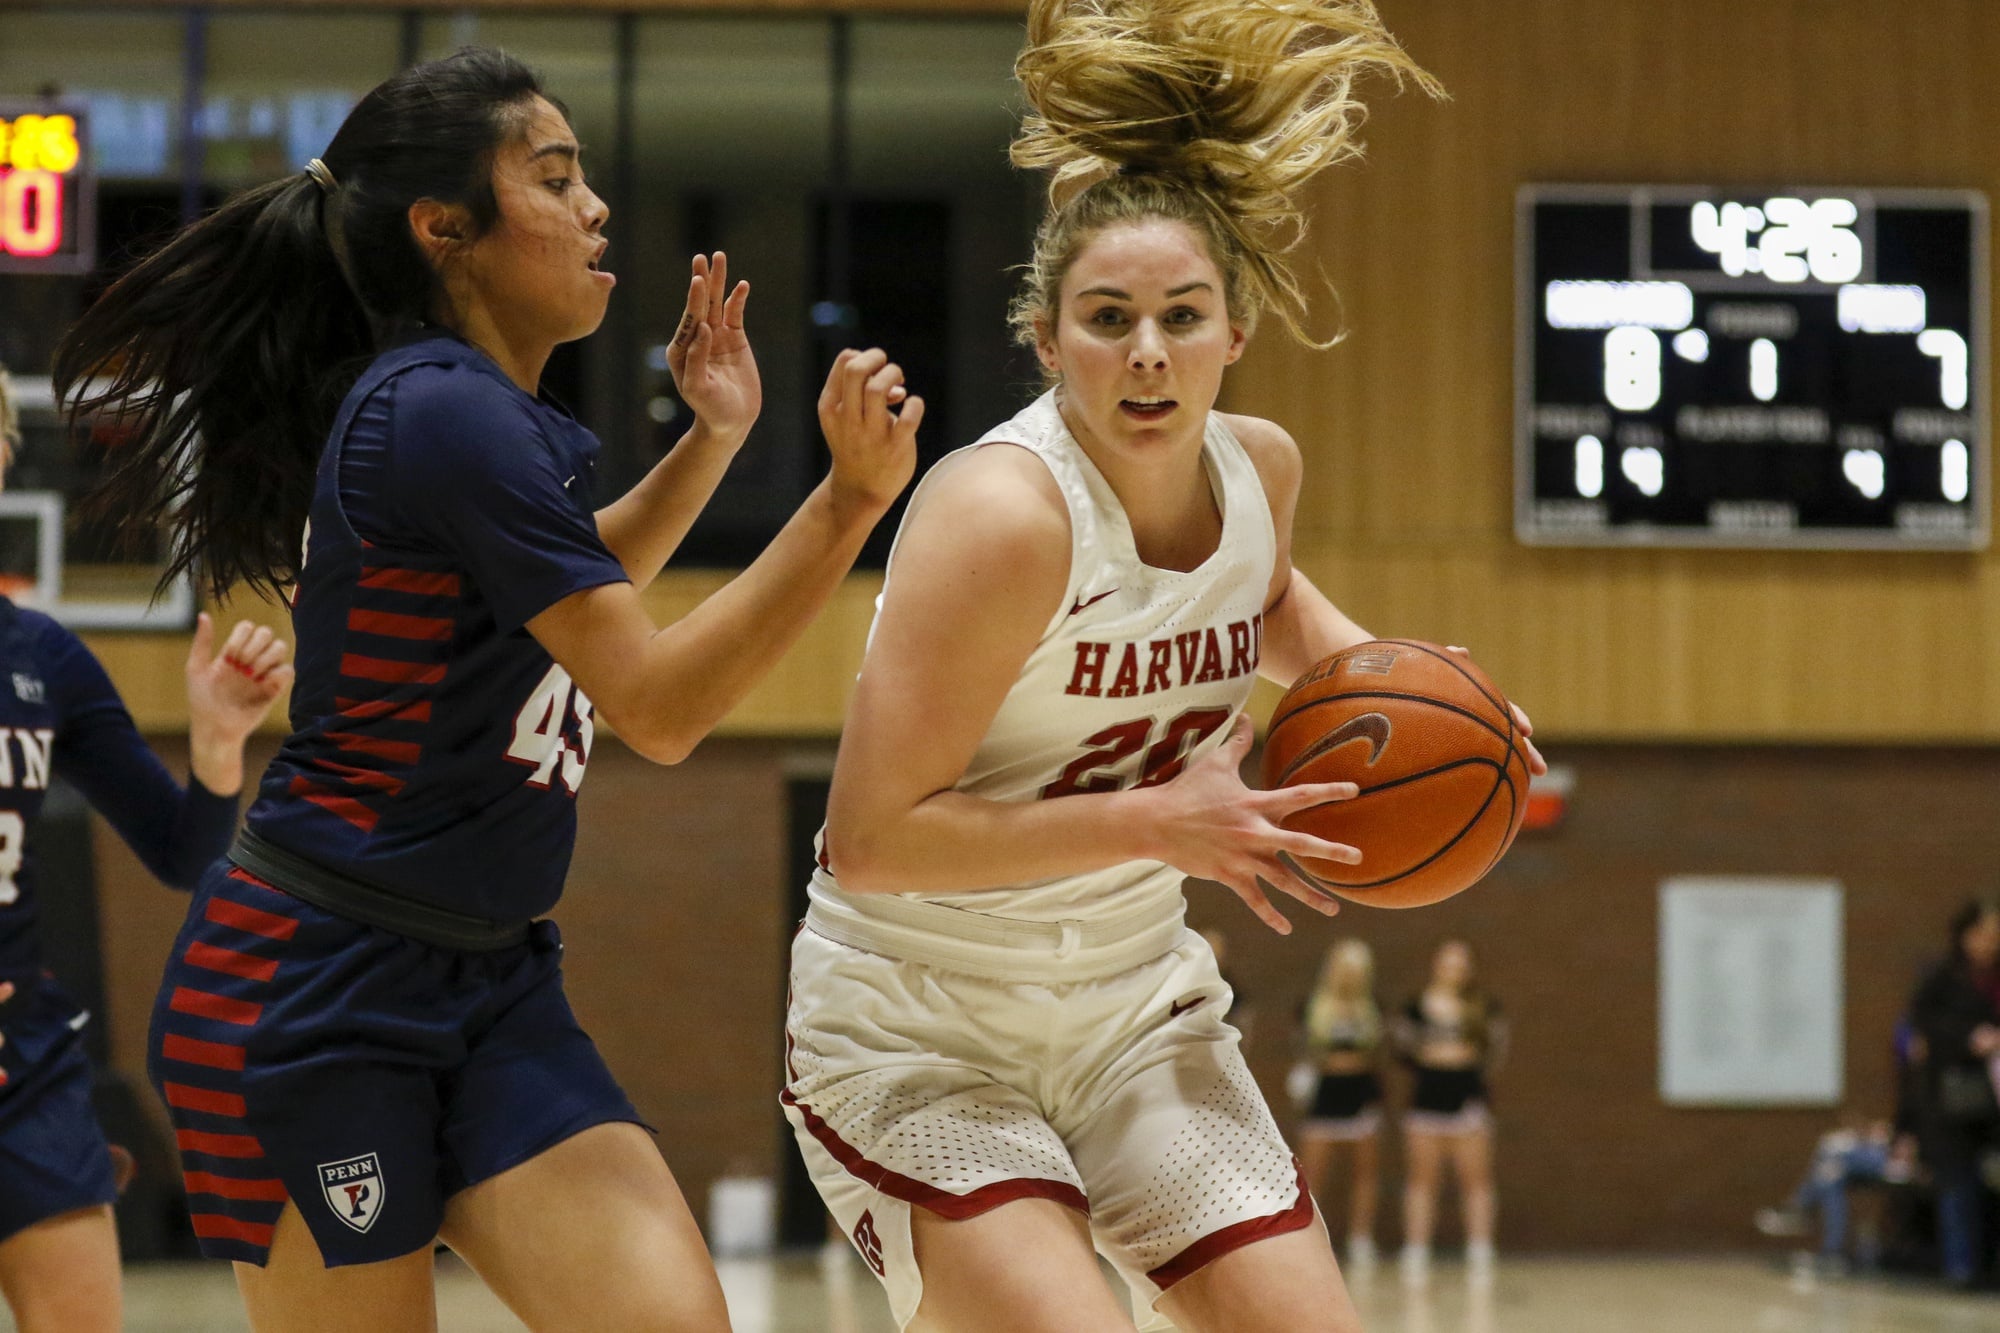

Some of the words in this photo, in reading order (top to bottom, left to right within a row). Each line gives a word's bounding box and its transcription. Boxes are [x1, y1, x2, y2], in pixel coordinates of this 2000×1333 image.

[1691, 197, 1862, 283] 4:26
[1917, 329, 1967, 410] 7
[1037, 704, 1234, 800] 20
[325, 1160, 374, 1182] PENN
[343, 1183, 370, 1219] P
